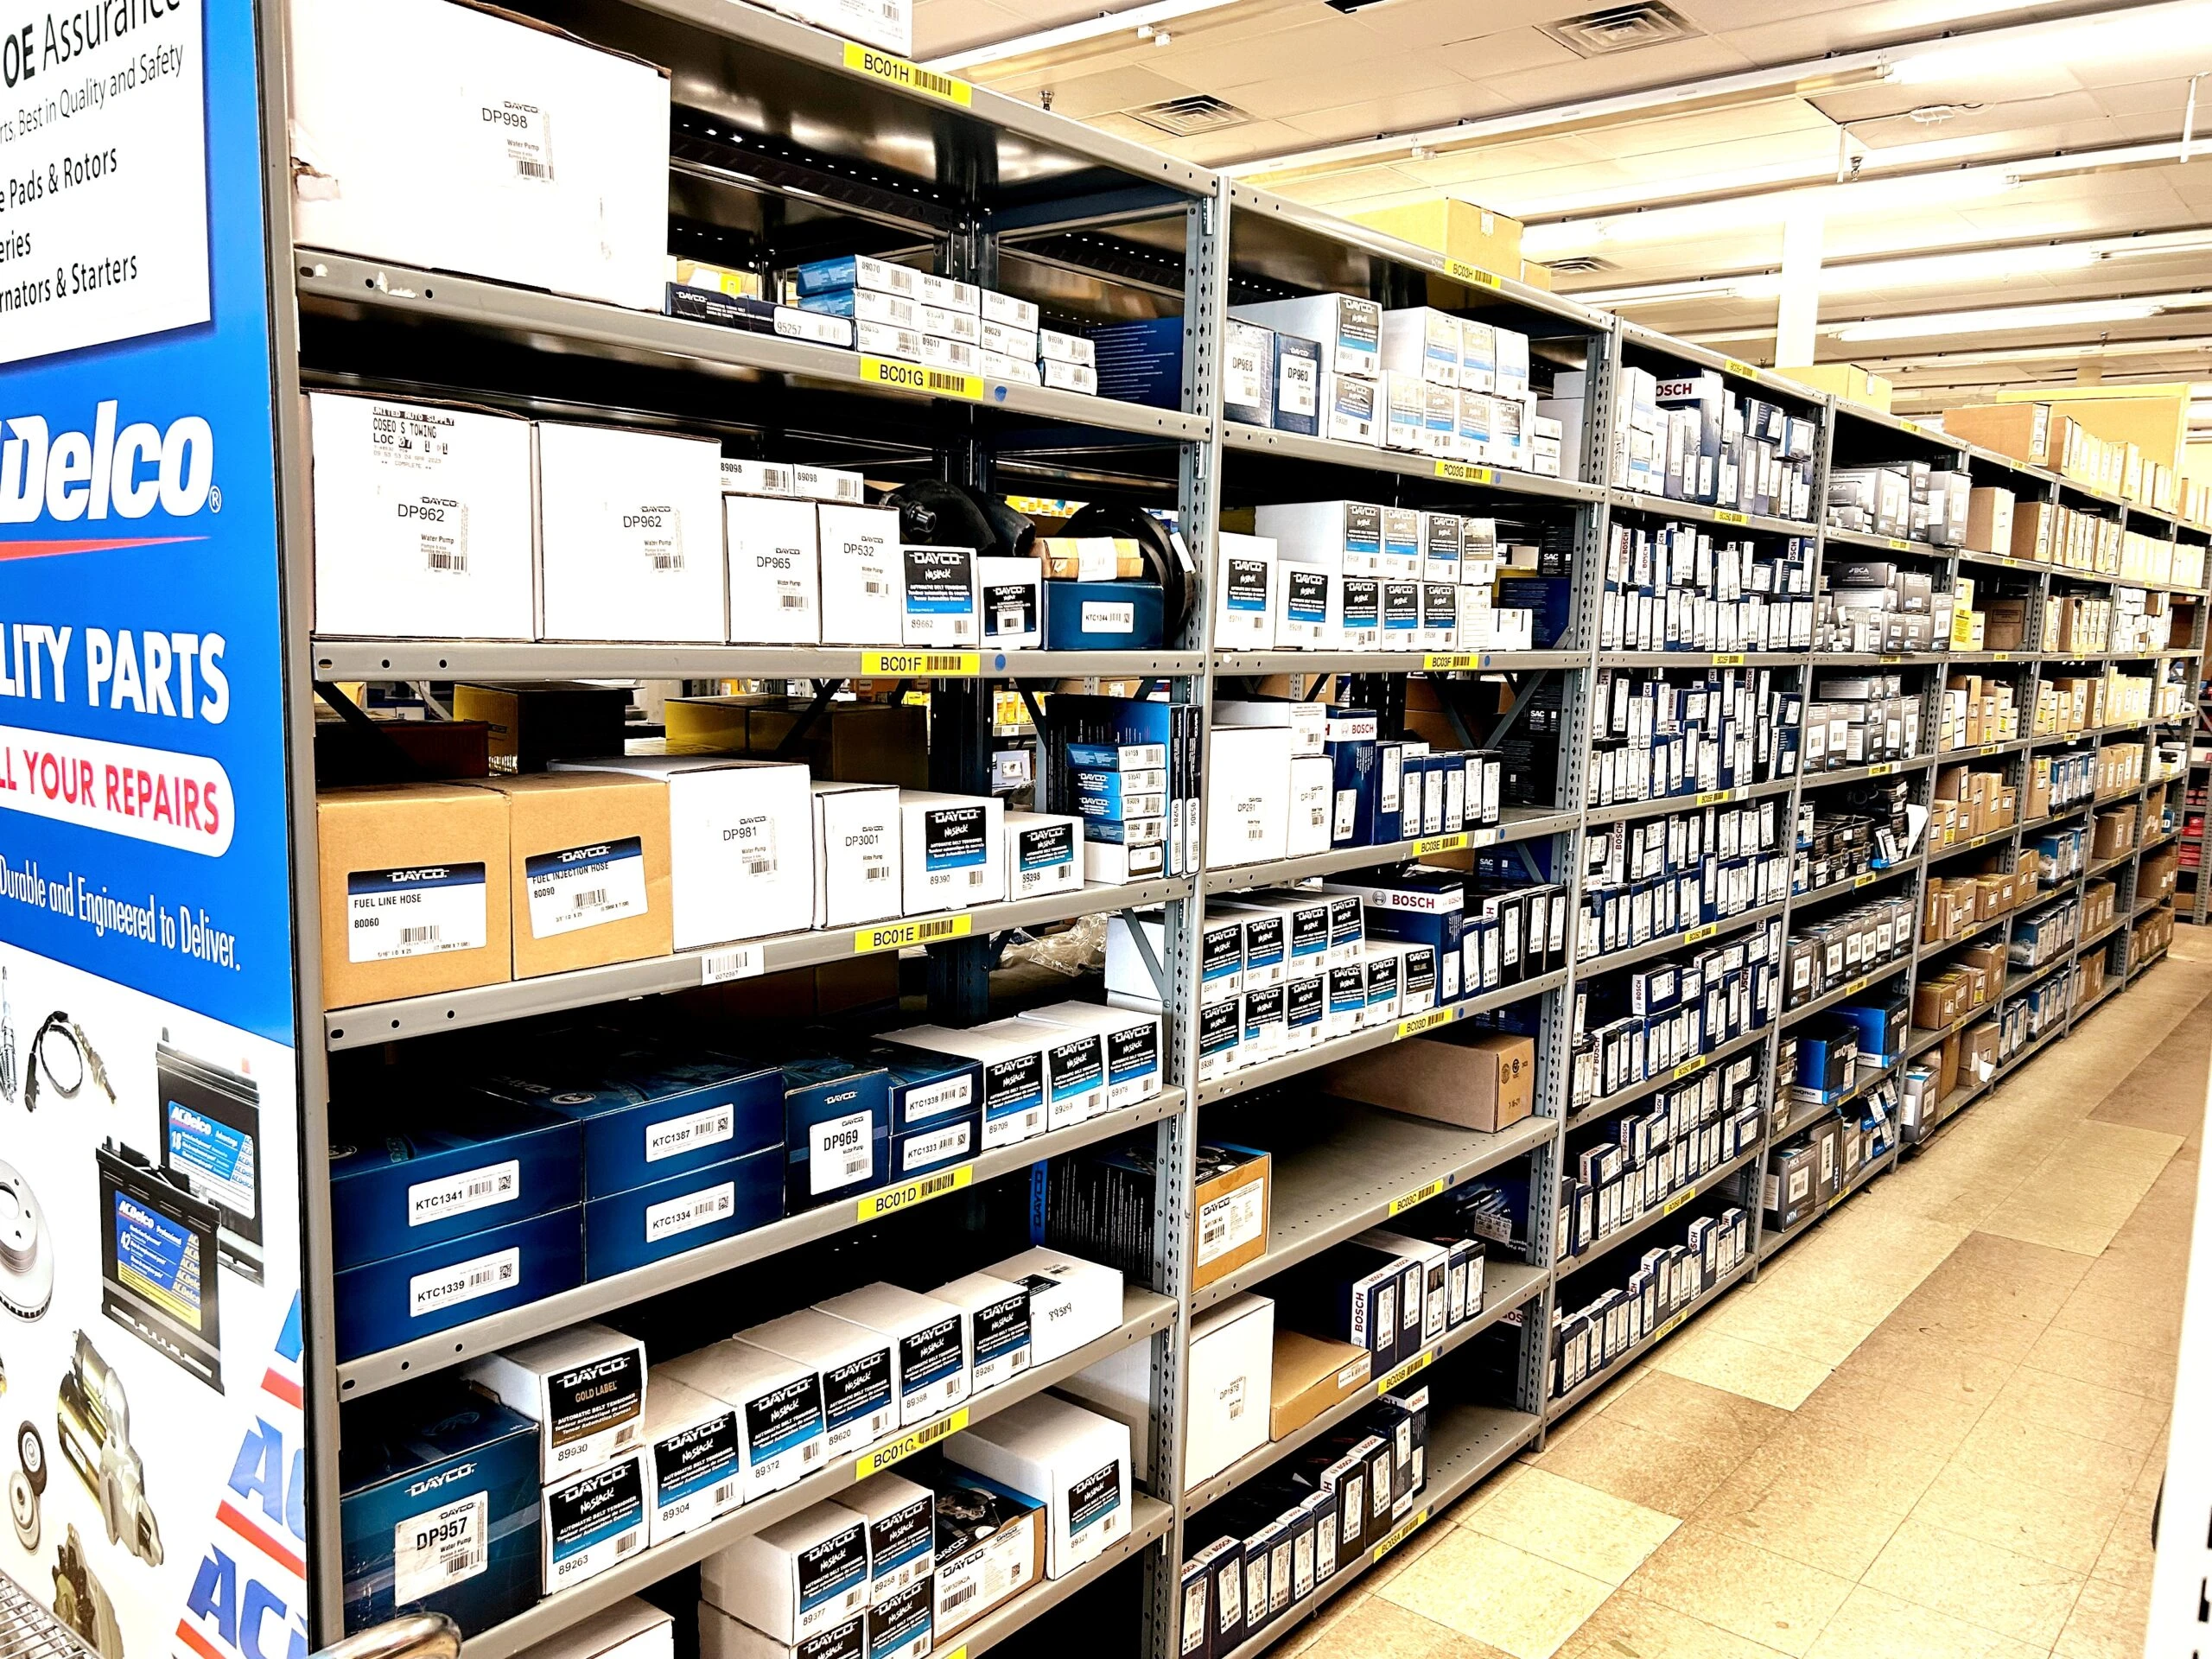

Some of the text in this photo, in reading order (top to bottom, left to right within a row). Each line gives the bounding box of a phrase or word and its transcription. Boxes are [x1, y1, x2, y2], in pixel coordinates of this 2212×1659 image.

[3, 23, 35, 88] OE
[864, 53, 909, 83] BC01H
[19, 107, 43, 136] Best
[46, 98, 57, 123] in
[60, 78, 105, 118] Quality
[110, 58, 136, 97] and
[140, 44, 183, 86] Safety
[481, 107, 528, 129] DP998
[507, 139, 539, 151] Water Pump
[10, 148, 118, 209] Pads & Rotors
[861, 262, 880, 274] 89070
[1452, 264, 1473, 279] BC03H
[56, 268, 67, 298] &
[73, 255, 137, 295] Starters
[924, 277, 942, 288] 89144
[1343, 299, 1376, 314] DAYCO
[777, 321, 802, 335] 95257
[984, 326, 1001, 337] 89029
[922, 337, 940, 348] 89017
[1232, 357, 1253, 372] DP968
[879, 363, 925, 388] BC01G
[1287, 367, 1308, 382] DP960
[426, 414, 454, 427] SUPPLY
[373, 432, 394, 445] LOC
[410, 423, 437, 439] TOWING
[721, 462, 742, 474] 89098
[798, 472, 817, 483] 89098
[420, 496, 460, 508] DAYCO
[397, 504, 445, 522] DP962
[1349, 505, 1377, 516] DAYCO
[623, 515, 662, 529] DP962
[1432, 517, 1457, 526] DAYCO
[421, 533, 454, 545] Water Pump
[843, 543, 874, 557] DP532
[757, 556, 791, 569] DP965
[909, 551, 964, 566] DAYCO
[1231, 560, 1265, 571] DAYCO
[1294, 574, 1325, 585] DAYCO
[1346, 582, 1376, 592] DAYCO
[1387, 586, 1414, 594] DAYCO
[1427, 586, 1454, 594] DAYCO
[1085, 613, 1109, 623] KTC1344
[880, 656, 922, 672] BC01F
[86, 626, 230, 725] PARTS
[1351, 724, 1374, 734] BOSCH
[23, 749, 97, 808] YOUR
[105, 764, 219, 836] REPAIRS
[930, 809, 981, 823] DAYCO
[1237, 804, 1255, 812] DP291
[723, 827, 757, 842] DP981
[845, 834, 880, 847] DP3001
[1027, 828, 1066, 842] DAYCO
[1615, 822, 1624, 851] BOSCH
[557, 846, 611, 862] DAYCO
[1479, 858, 1493, 867] SAC
[387, 868, 449, 882] DAYCO
[532, 862, 609, 885] FUEL INJECTION HOSE
[930, 874, 950, 885] 89390
[1022, 872, 1041, 884] 89398
[534, 887, 555, 899] 80090
[1392, 894, 1434, 908] BOSCH
[1448, 896, 1462, 905] BOSCH
[353, 893, 422, 910] FUEL LINE HOSE
[1332, 899, 1357, 912] DAYCO
[49, 871, 241, 972] and Engineered to Deliver.
[1296, 908, 1325, 921] DAYCO
[354, 918, 379, 929] 80060
[1249, 918, 1280, 932] DAYCO
[874, 926, 914, 947] BC01E
[1205, 927, 1239, 944] DAYCO
[1408, 950, 1432, 962] DAYCO
[1332, 966, 1362, 978] DAYCO
[1370, 958, 1395, 972] DAYCO
[1291, 980, 1320, 994] DAYCO
[1250, 989, 1280, 1002] DAYCO
[1202, 1002, 1236, 1019] DAYCO
[1111, 1025, 1154, 1043] DAYCO
[1053, 1038, 1096, 1058] DAYCO
[990, 1055, 1035, 1077] DAYCO
[988, 1121, 1008, 1134] 89709
[652, 1129, 690, 1148] KTC1387
[823, 1129, 859, 1151] DP969
[907, 1143, 937, 1160] KTC1333
[416, 1190, 463, 1211] KTC1341
[876, 1187, 917, 1212] BC01D
[1203, 1196, 1232, 1216] DAYCO
[1397, 1194, 1417, 1211] BC03C
[652, 1211, 691, 1230] KTC1334
[417, 1280, 465, 1302] KTC1339
[980, 1296, 1026, 1320] DAYCO
[1355, 1293, 1364, 1332] BOSCH
[906, 1319, 957, 1347] DAYCO
[556, 1357, 631, 1389] DAYCO
[830, 1352, 886, 1381] DAYCO
[575, 1381, 618, 1403] GOLD LABEL
[753, 1378, 813, 1411] DAYCO
[1412, 1395, 1425, 1407] BOSCH
[558, 1409, 591, 1425] AUTOMATIC
[662, 1416, 729, 1452] DAYCO
[557, 1444, 588, 1461] 89930
[755, 1460, 779, 1478] 89372
[404, 1463, 478, 1497] DAYCO
[558, 1464, 632, 1503] DAYCO
[1071, 1464, 1115, 1494] DAYCO
[439, 1502, 476, 1520] DAYCO
[663, 1503, 690, 1522] 89304
[875, 1500, 927, 1533] DAYCO
[416, 1517, 467, 1551] DP957
[440, 1536, 472, 1553] Water Pump
[804, 1528, 859, 1562] DAYCO
[1212, 1539, 1232, 1552] BOSCH
[558, 1555, 588, 1575] 89263
[938, 1547, 988, 1579] DAYCO
[874, 1580, 925, 1616] DAYCO
[803, 1607, 826, 1626] 89377
[803, 1621, 858, 1656] DAYCO
